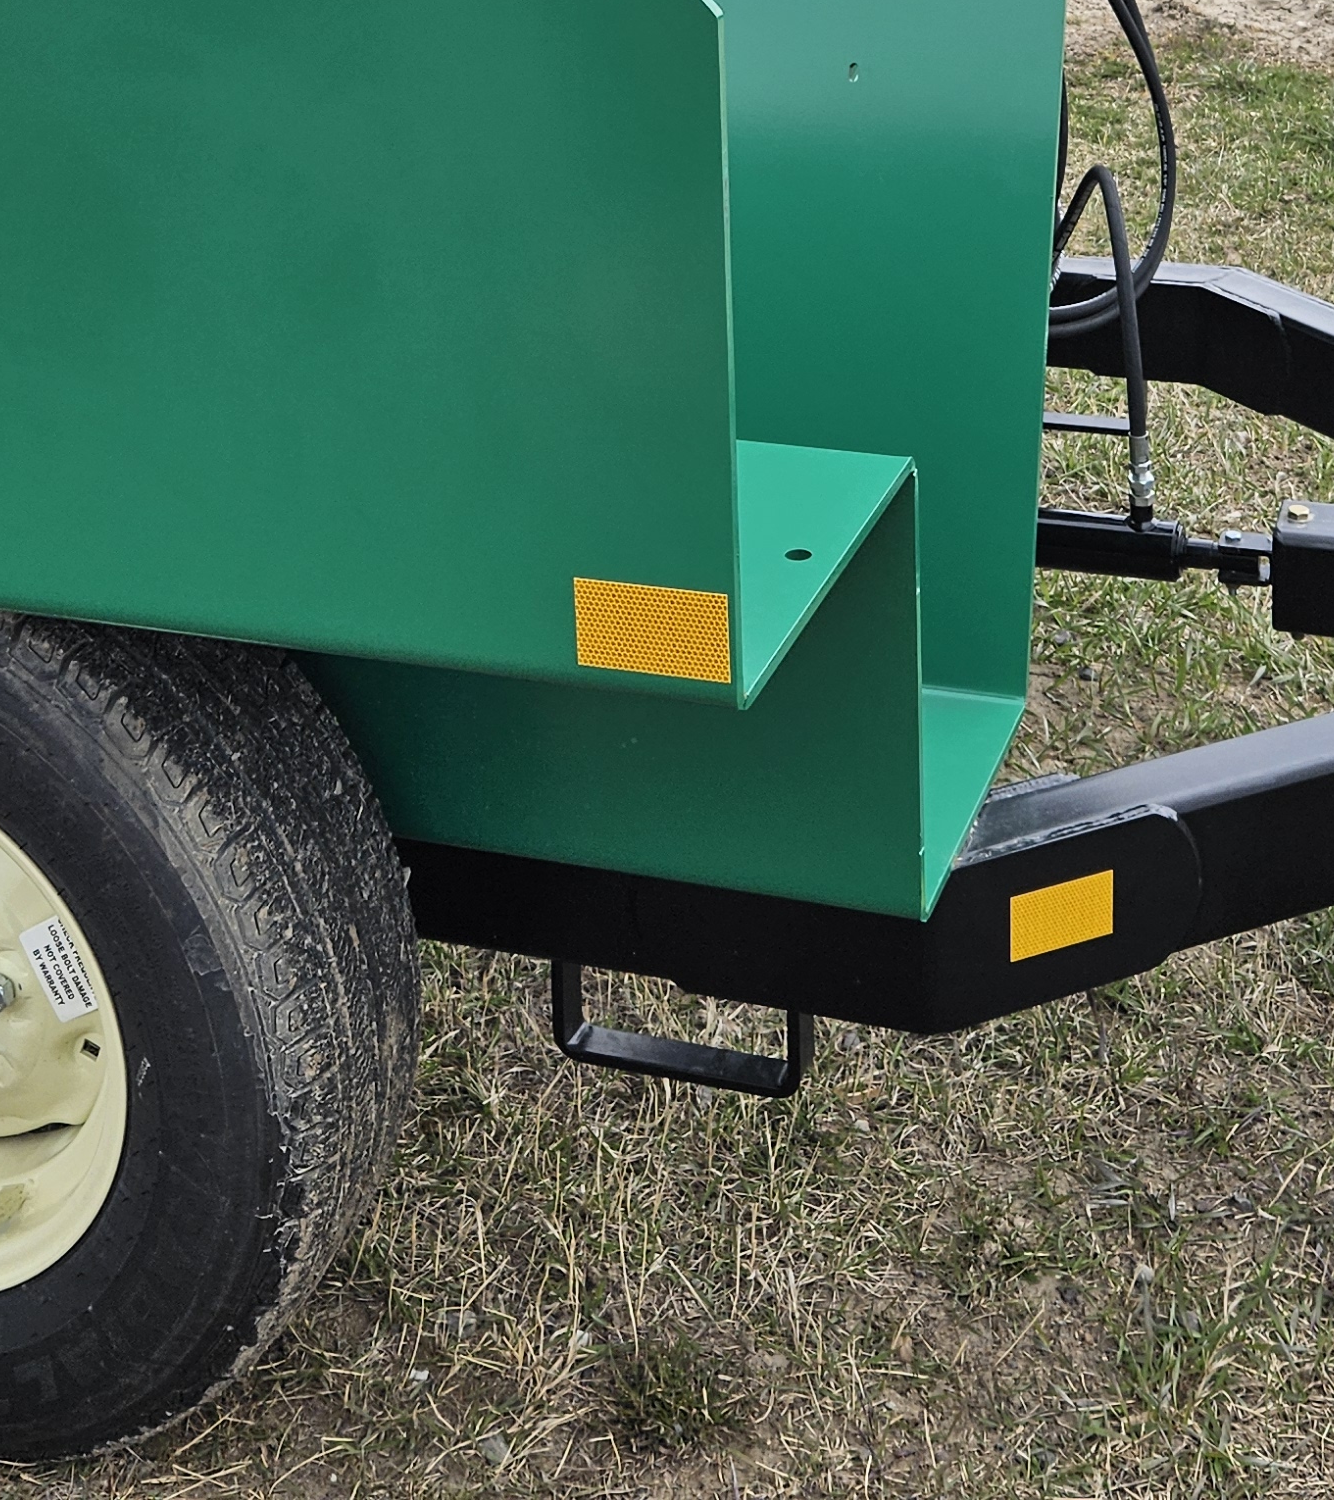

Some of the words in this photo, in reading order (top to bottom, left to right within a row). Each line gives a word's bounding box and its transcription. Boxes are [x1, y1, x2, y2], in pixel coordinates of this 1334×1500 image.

[32, 948, 43, 961] BY
[38, 962, 66, 1006] WARRANTY
[43, 944, 57, 962] NOT
[52, 963, 75, 1000] COVERED
[47, 924, 65, 953] LOOSE
[60, 953, 76, 975] BOLT
[71, 975, 93, 1009] DAMAGE
